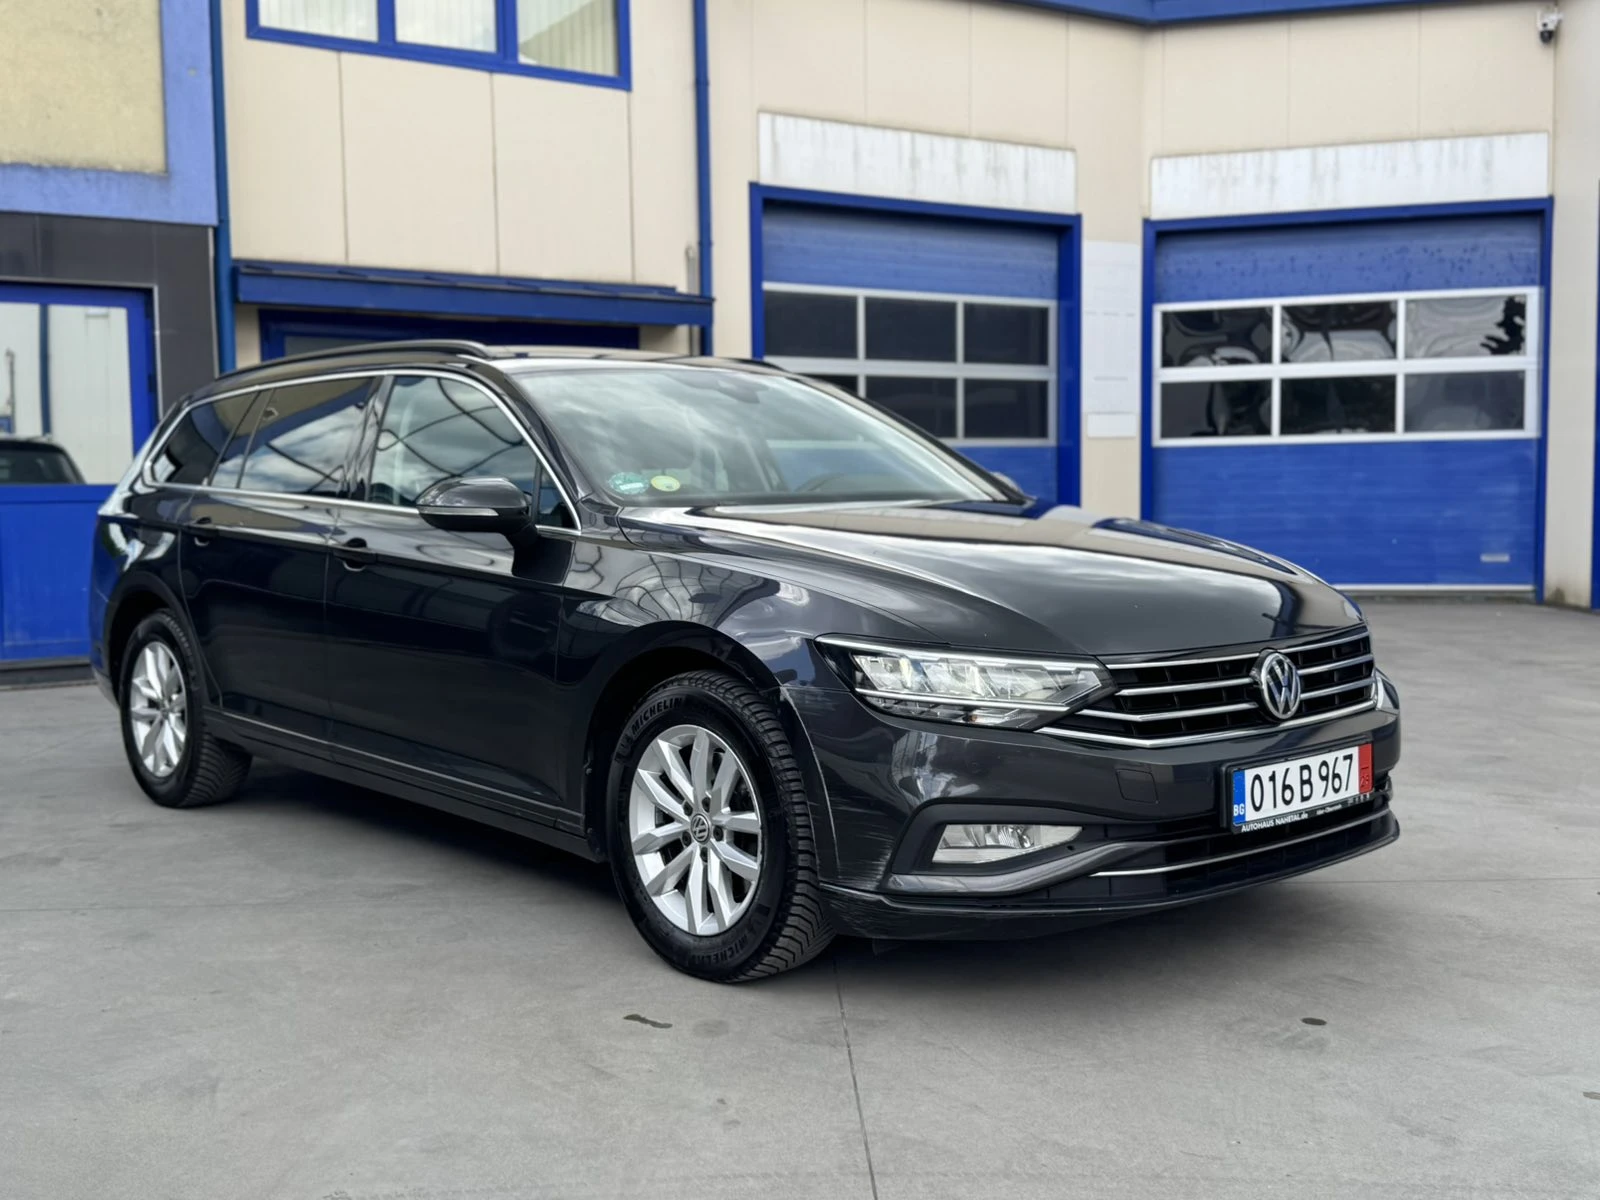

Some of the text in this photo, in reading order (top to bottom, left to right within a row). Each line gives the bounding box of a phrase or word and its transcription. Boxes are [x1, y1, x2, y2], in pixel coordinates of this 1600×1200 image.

[632, 697, 682, 735] MICHELIN
[1233, 802, 1245, 817] BG
[1241, 819, 1275, 832] AUTOHAUS
